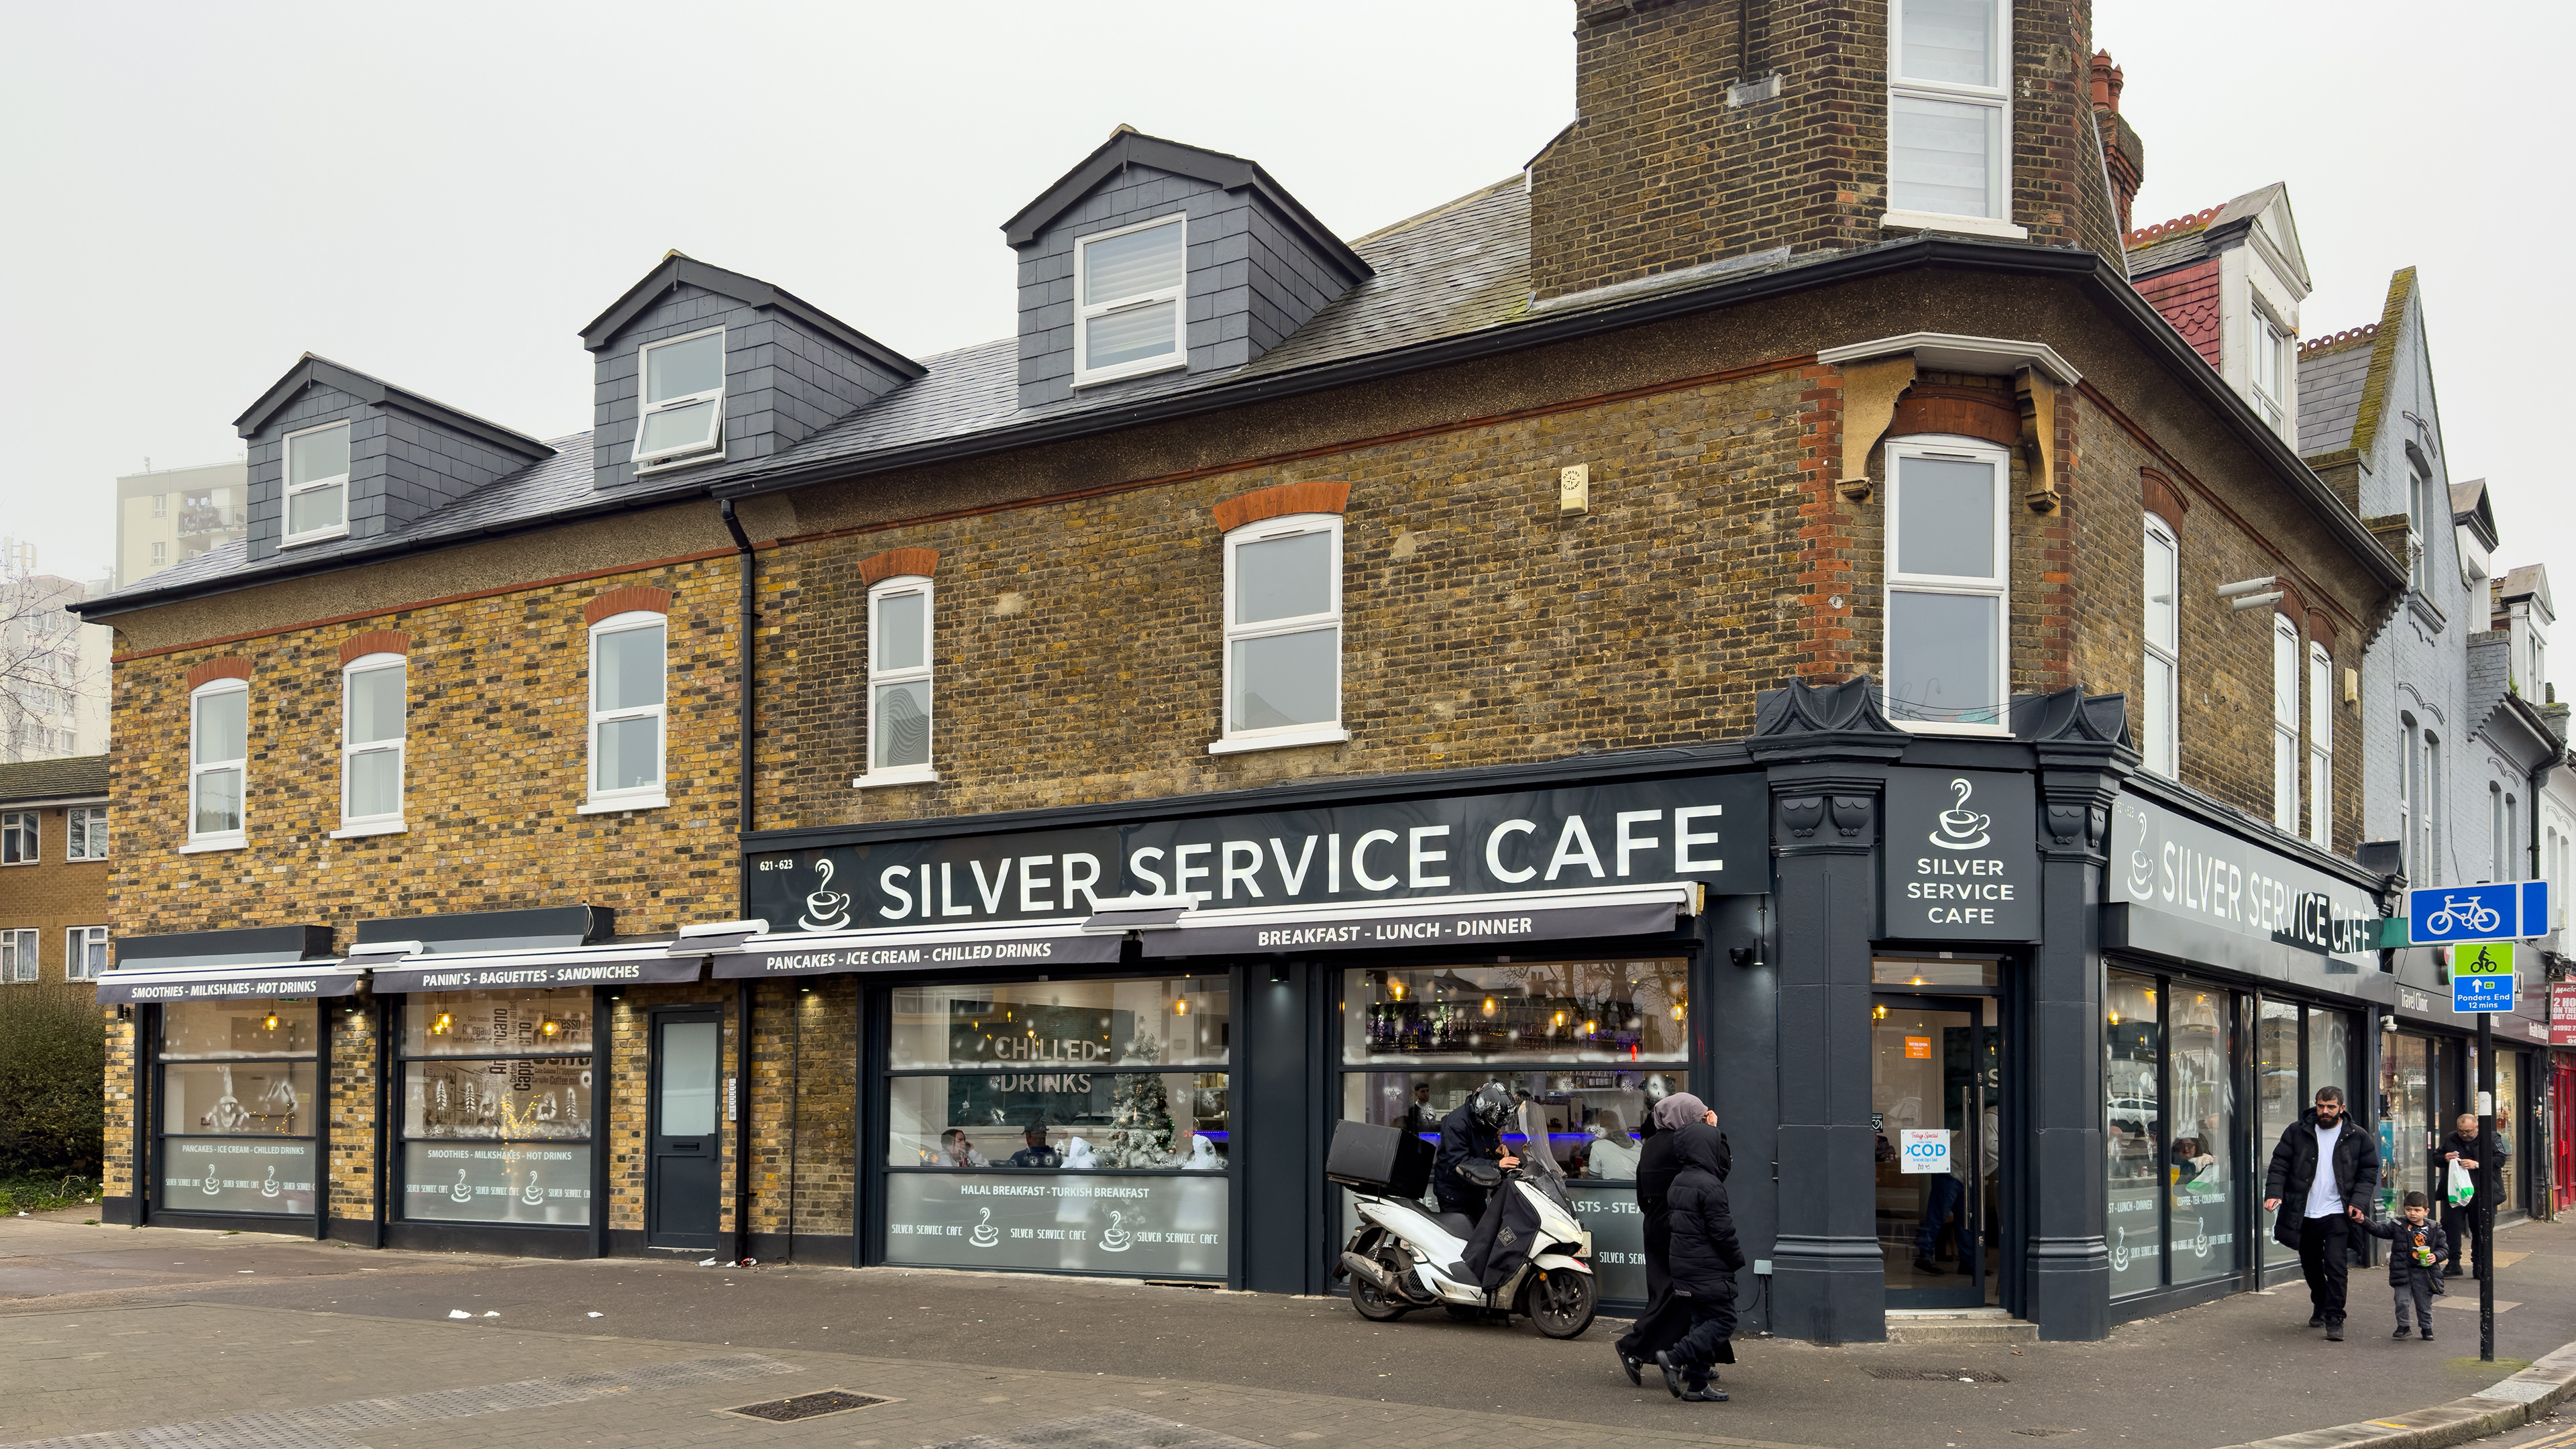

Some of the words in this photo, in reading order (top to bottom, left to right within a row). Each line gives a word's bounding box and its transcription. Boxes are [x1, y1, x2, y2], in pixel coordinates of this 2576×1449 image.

[1563, 470, 1580, 479] ALBANY
[1562, 481, 1580, 490] ALARMS
[879, 853, 1099, 920] SILVER
[1130, 824, 1450, 900] SERVICE
[1486, 805, 1723, 883] CAFE
[1917, 858, 2004, 876] SILVER
[1907, 882, 2015, 900] SERVICE
[2162, 841, 2242, 922] SILVER
[2249, 872, 2326, 946] SERVICE
[2332, 902, 2371, 959] CAFE
[1928, 907, 1994, 924] CAFE
[1258, 926, 1360, 947] BREAKFAST
[1377, 922, 1440, 941] LUNCH
[1457, 917, 1532, 937] DINNER
[766, 953, 835, 970] PANCAKES
[846, 951, 868, 965] ICE
[871, 949, 920, 965] CREAM
[932, 945, 993, 961] CHILLED
[995, 943, 1052, 959] DRINKS
[480, 970, 547, 984] BAGUETTES
[557, 965, 639, 981] SANDWICHES
[131, 985, 184, 998] SMOOTHIES
[191, 982, 250, 996] MILKSHAKES
[256, 981, 278, 994] HOT
[279, 980, 317, 993] DRINKS
[2401, 989, 2414, 1010] Travel
[2415, 992, 2428, 1012] Clinic
[2554, 998, 2561, 1007] 2
[489, 1008, 508, 1075] Amricano
[995, 1036, 1097, 1061] CHILLED
[1000, 1073, 1091, 1093] DRINKS
[182, 1144, 213, 1152] PANCAKES
[217, 1145, 227, 1153] ICE
[254, 1146, 280, 1154] CHILLED
[280, 1146, 304, 1155] DRINKS
[427, 1150, 469, 1159] SMOOTHIES
[474, 1150, 521, 1159] MILKSHAKES
[527, 1151, 542, 1160] HOT
[544, 1152, 572, 1160] DRINKS
[1911, 1144, 1946, 1157] COD
[961, 1185, 991, 1195] HALAL
[993, 1186, 1045, 1196] BREAKFAST
[1051, 1187, 1092, 1197] TURKISH
[1094, 1188, 1149, 1197] BREAKFAST
[2117, 1201, 2133, 1212] LUNCH
[2136, 1199, 2153, 1211] DINNER
[2177, 1195, 2190, 1207] COFFEE
[2202, 1194, 2212, 1204] COLD
[2212, 1193, 2225, 1203] DRINKS
[892, 1224, 912, 1234] SILVER
[916, 1225, 943, 1235] SERVICE
[946, 1226, 963, 1236] CAFE
[1010, 1228, 1033, 1239] SILVER
[1037, 1229, 1065, 1240] SERVICE
[1069, 1230, 1086, 1240] CAFE
[1137, 1232, 1161, 1242] SILVER
[1165, 1232, 1195, 1244] SERVICE
[1200, 1234, 1218, 1244] CAFE
[1599, 1252, 1624, 1264] SILVER
[1629, 1253, 1646, 1265] SERV
